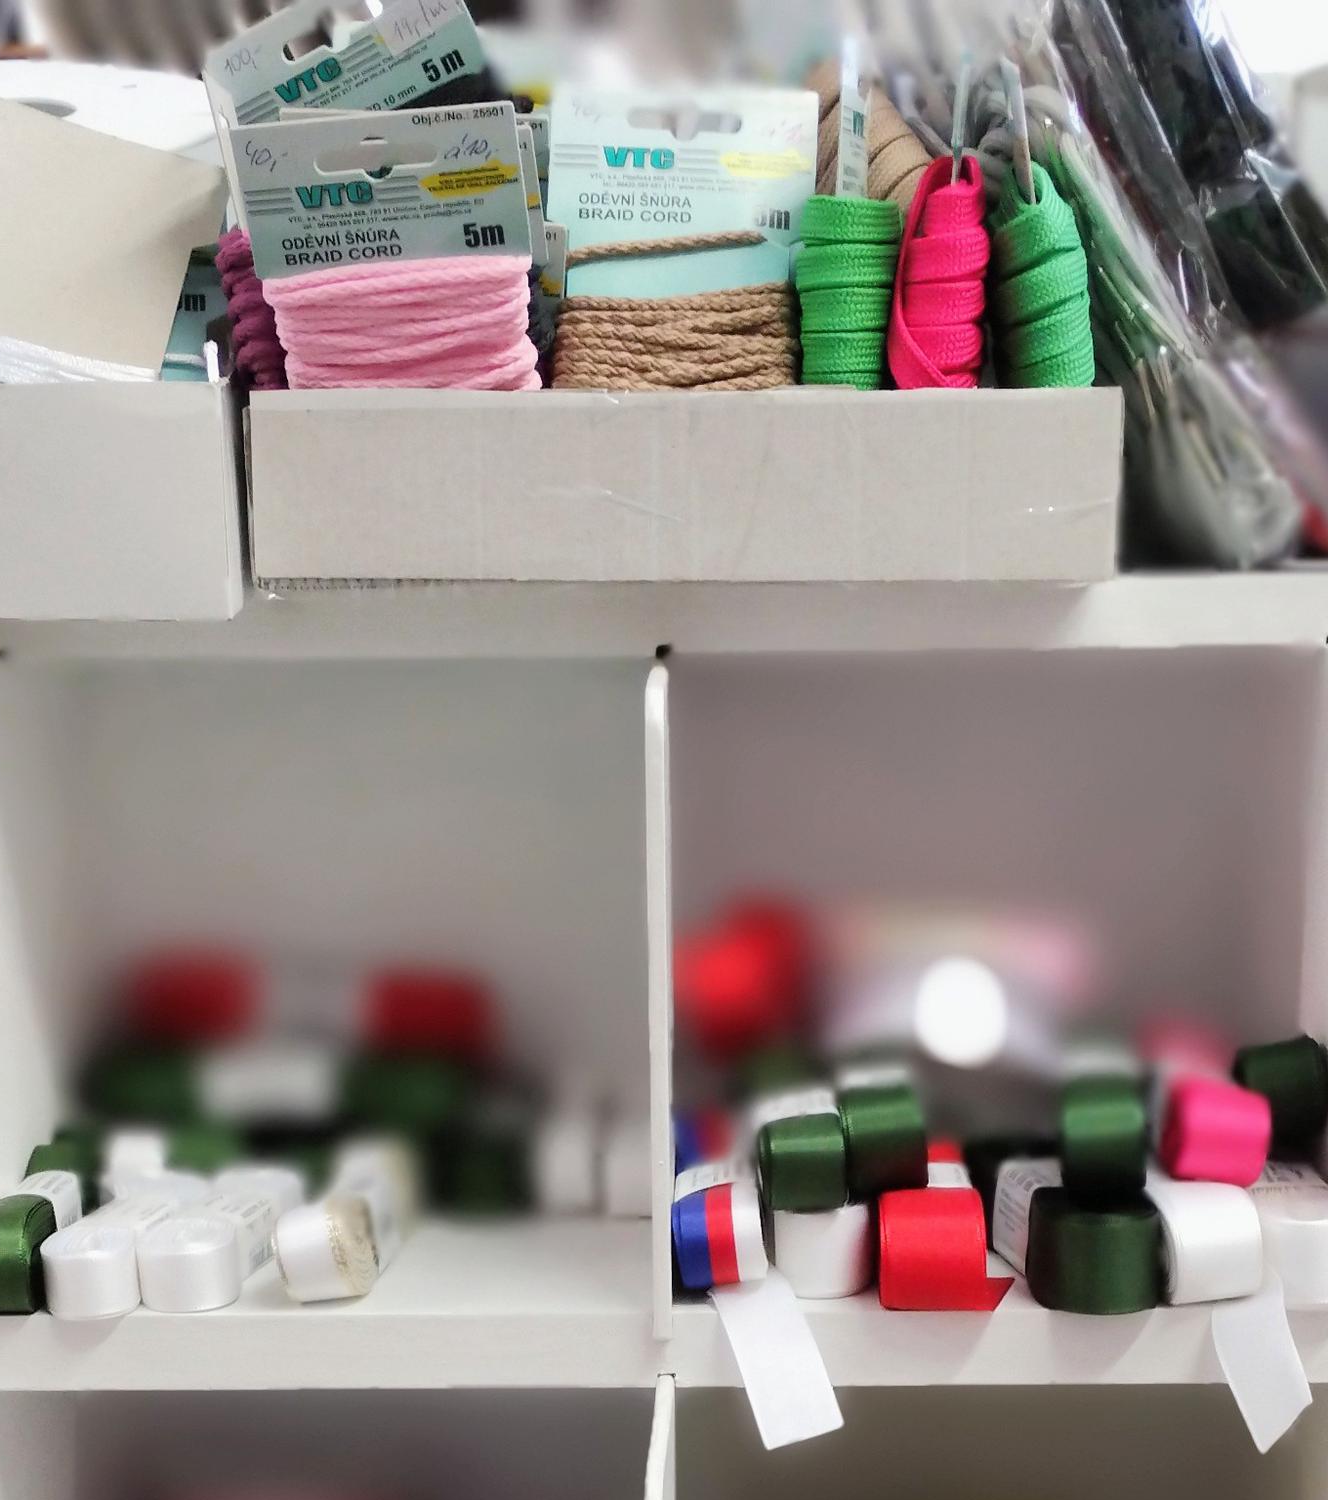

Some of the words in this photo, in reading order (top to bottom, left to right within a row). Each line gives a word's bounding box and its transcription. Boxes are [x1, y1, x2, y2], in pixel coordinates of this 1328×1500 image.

[273, 56, 342, 103] VTC
[602, 145, 675, 170] VTC
[295, 180, 374, 209] VTC
[578, 207, 634, 221] BRAID
[639, 209, 692, 224] CORD
[462, 222, 506, 249] 5m
[285, 250, 343, 266] BRAID
[348, 244, 403, 260] CORD
